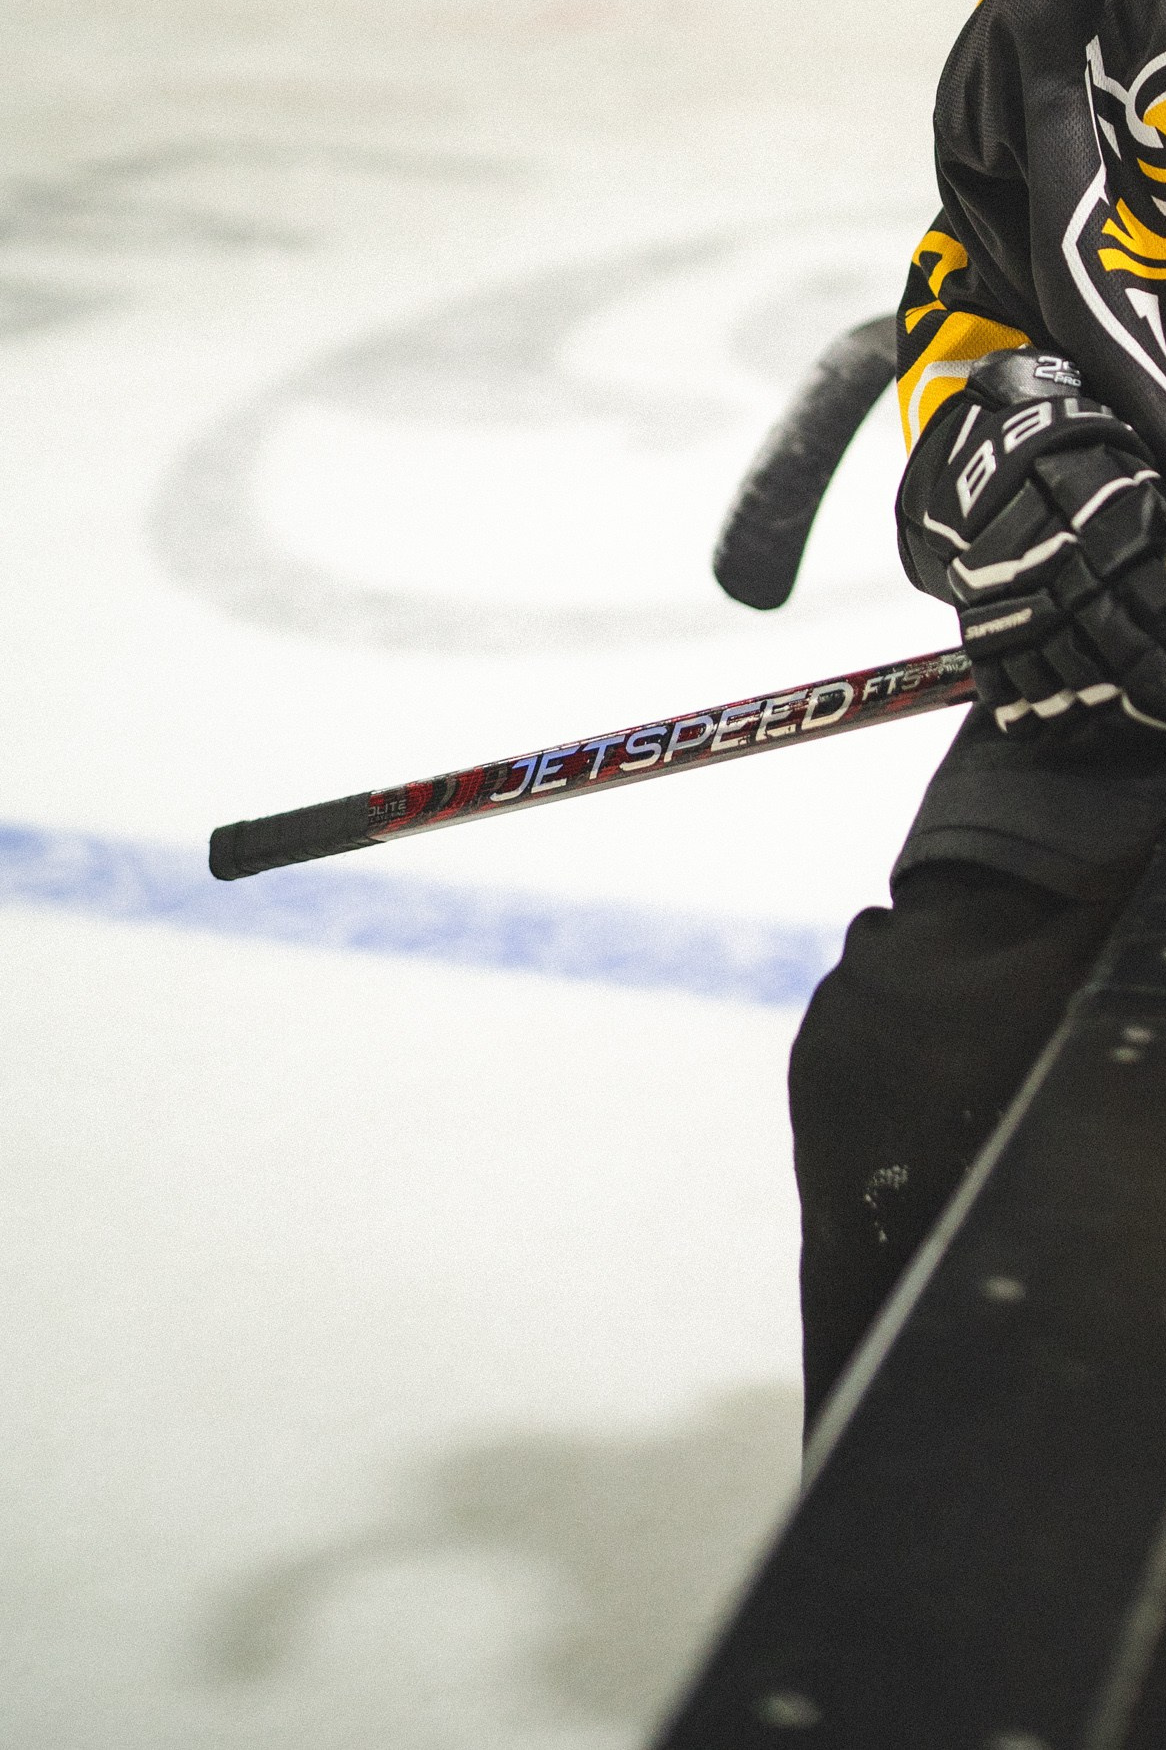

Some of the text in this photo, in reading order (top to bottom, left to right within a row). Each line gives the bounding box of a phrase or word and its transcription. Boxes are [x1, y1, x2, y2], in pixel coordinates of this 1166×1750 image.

[1053, 371, 1082, 387] PRO
[489, 670, 921, 802] JETSPEED FTS
